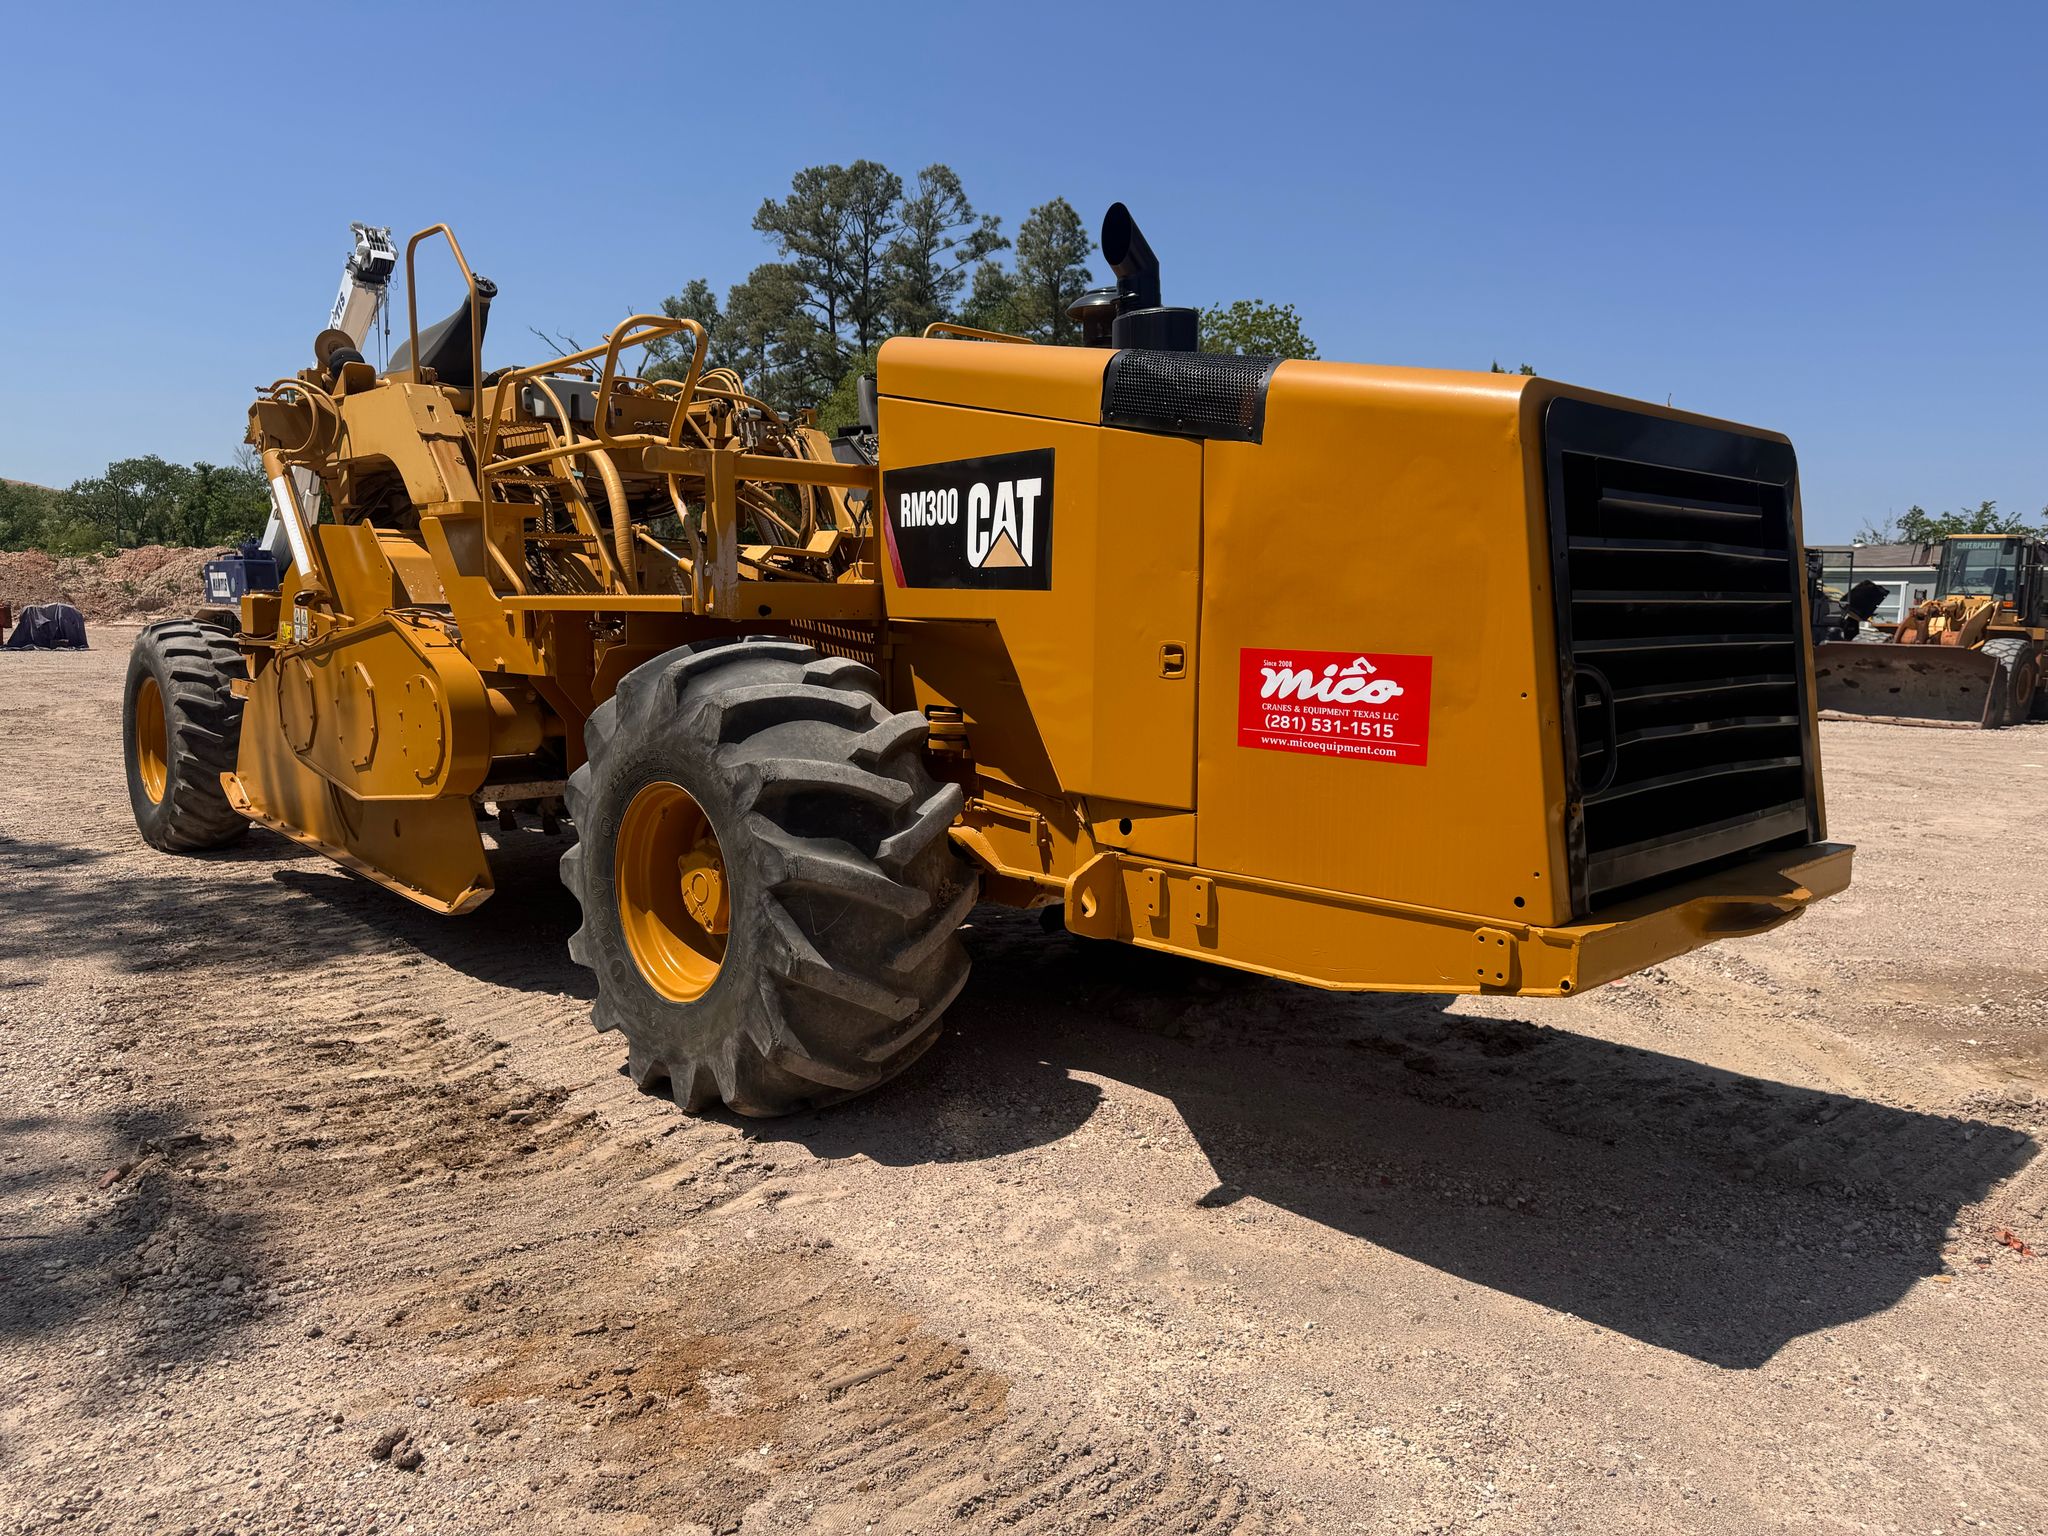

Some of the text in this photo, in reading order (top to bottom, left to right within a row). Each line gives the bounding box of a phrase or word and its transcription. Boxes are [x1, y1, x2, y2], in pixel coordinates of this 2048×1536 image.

[900, 477, 1042, 568] RM300 CAT
[1957, 541, 2000, 550] CATERPILLAR
[1263, 659, 1293, 668] Since 2008
[1261, 703, 1399, 721] CRANES & EQUIPMENT TEXAS LLC
[1264, 713, 1394, 738] (281) 531-1515
[1261, 735, 1397, 757] www.micoequipment.com
